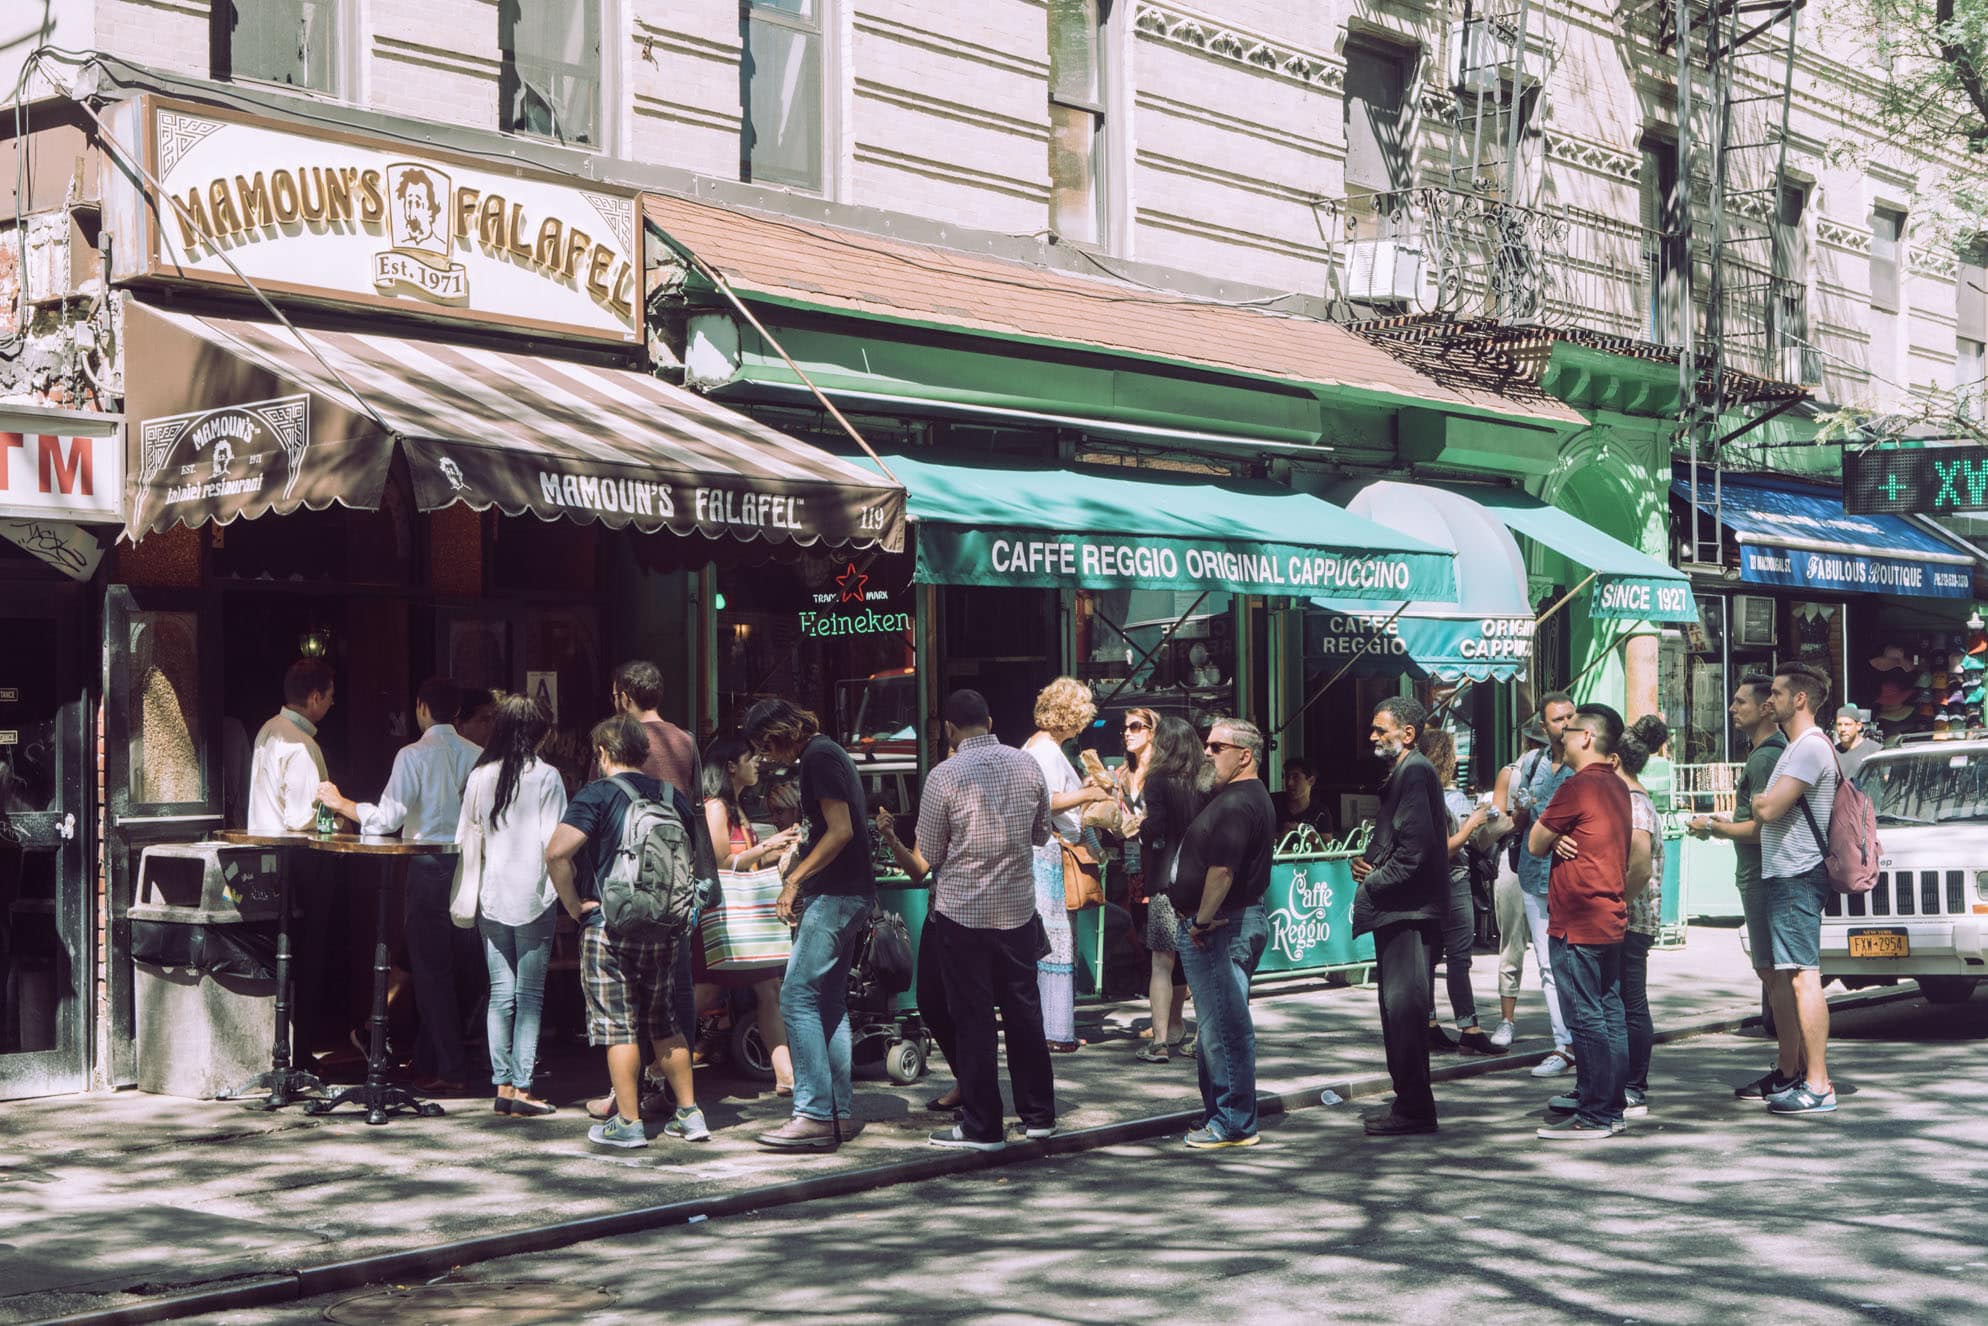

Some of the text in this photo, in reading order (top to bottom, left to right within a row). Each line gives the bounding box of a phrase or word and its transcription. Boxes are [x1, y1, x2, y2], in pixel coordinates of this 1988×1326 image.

[170, 166, 633, 319] MAMOUN'S FALAFEL
[379, 256, 463, 294] Est. 1971
[192, 416, 255, 451] MAMOUN'S
[539, 471, 802, 529] MAMOUN'S FALAFEL
[858, 506, 885, 530] 119
[991, 539, 1410, 590] CAFFE REGGIO ORIGINAL CAPPUCCINO
[1806, 555, 1867, 583] FABULOUS
[1868, 562, 1923, 588] BOUTIQUE
[1601, 583, 1687, 612] SINCE 1927
[798, 608, 912, 637] Heineken
[1329, 616, 1400, 635] CAFFE
[1323, 637, 1407, 656] REGGIO
[1288, 868, 1334, 921] Caffe
[1267, 907, 1331, 963] Reggio
